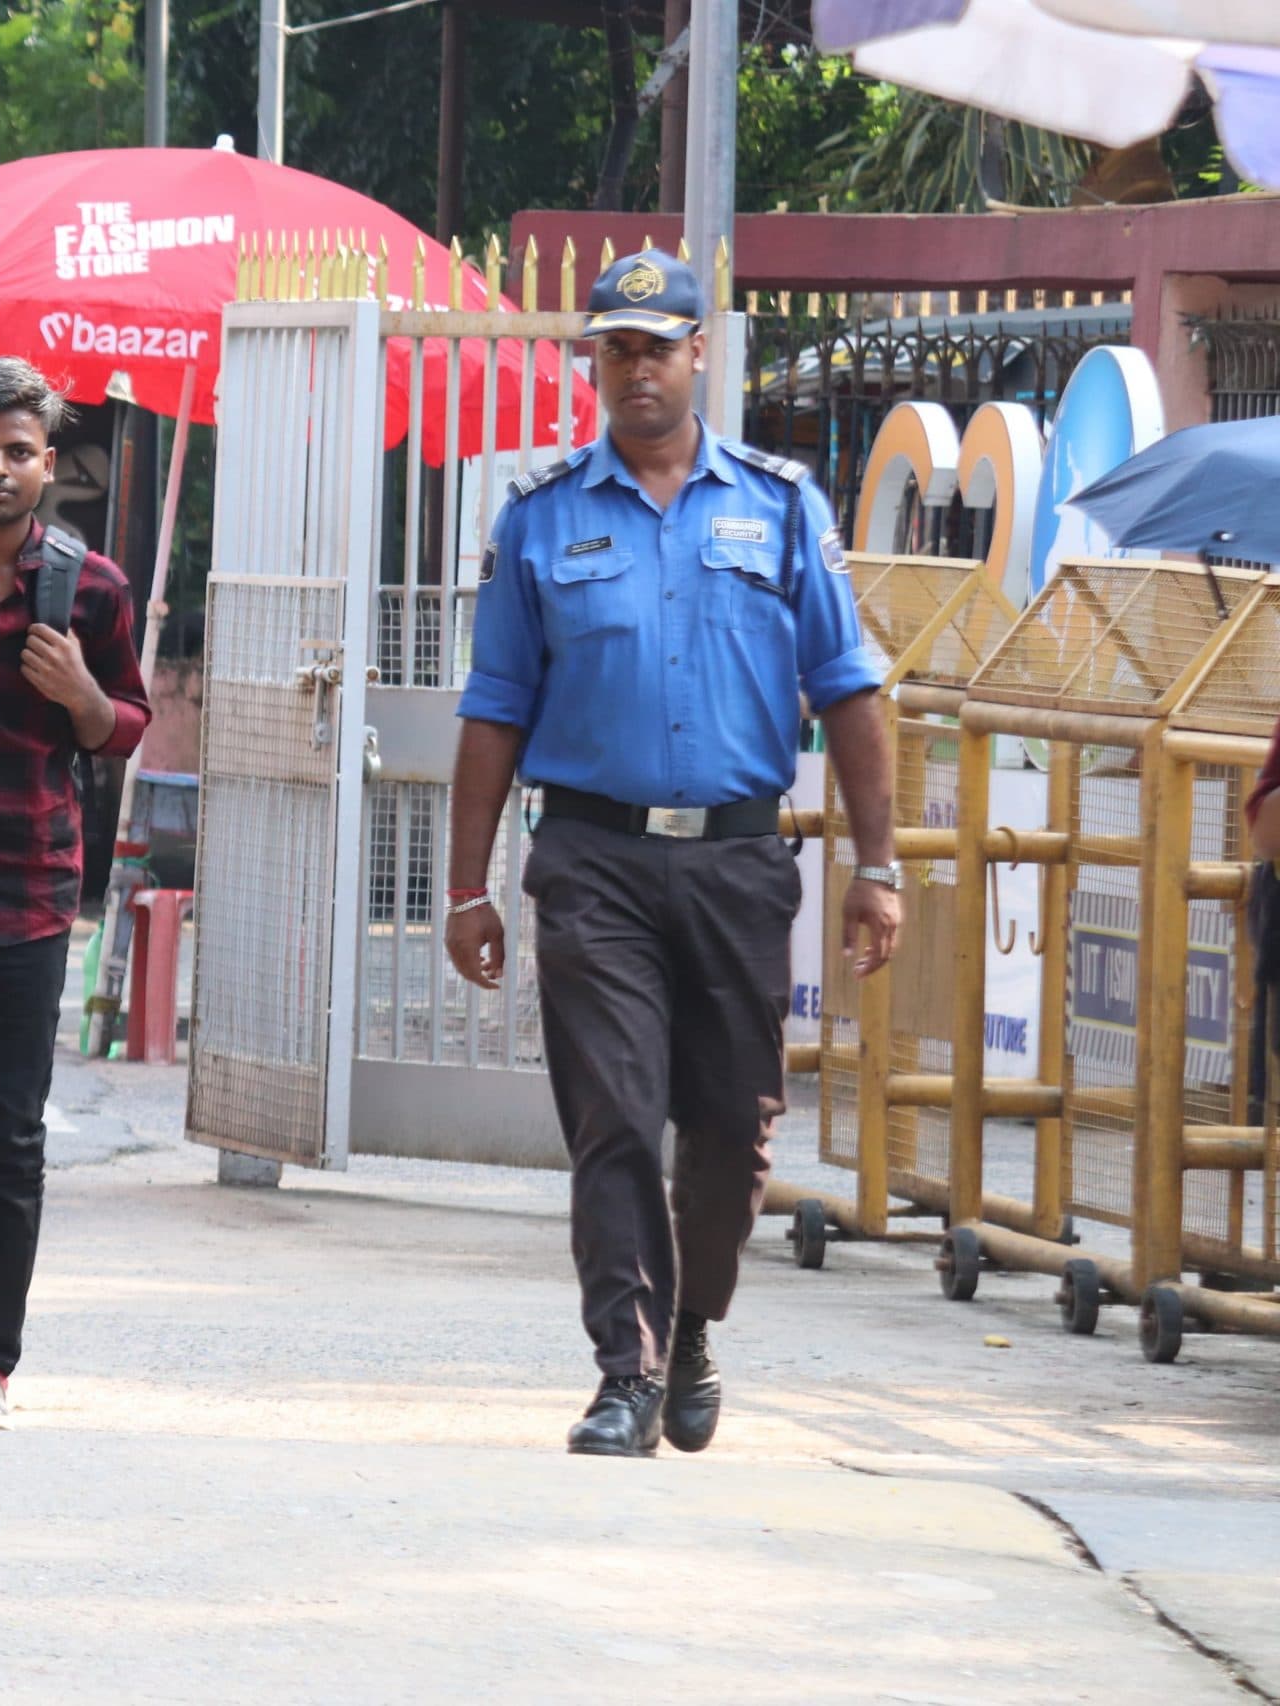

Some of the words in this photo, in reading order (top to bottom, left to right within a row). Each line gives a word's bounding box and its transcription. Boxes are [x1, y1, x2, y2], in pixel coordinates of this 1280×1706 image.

[77, 201, 131, 225] THE
[54, 214, 235, 256] FASHION
[55, 251, 150, 281] STORE
[720, 529, 758, 540] SECURITY
[1081, 942, 1102, 991] IIT
[982, 1012, 1028, 1055] UTURE
